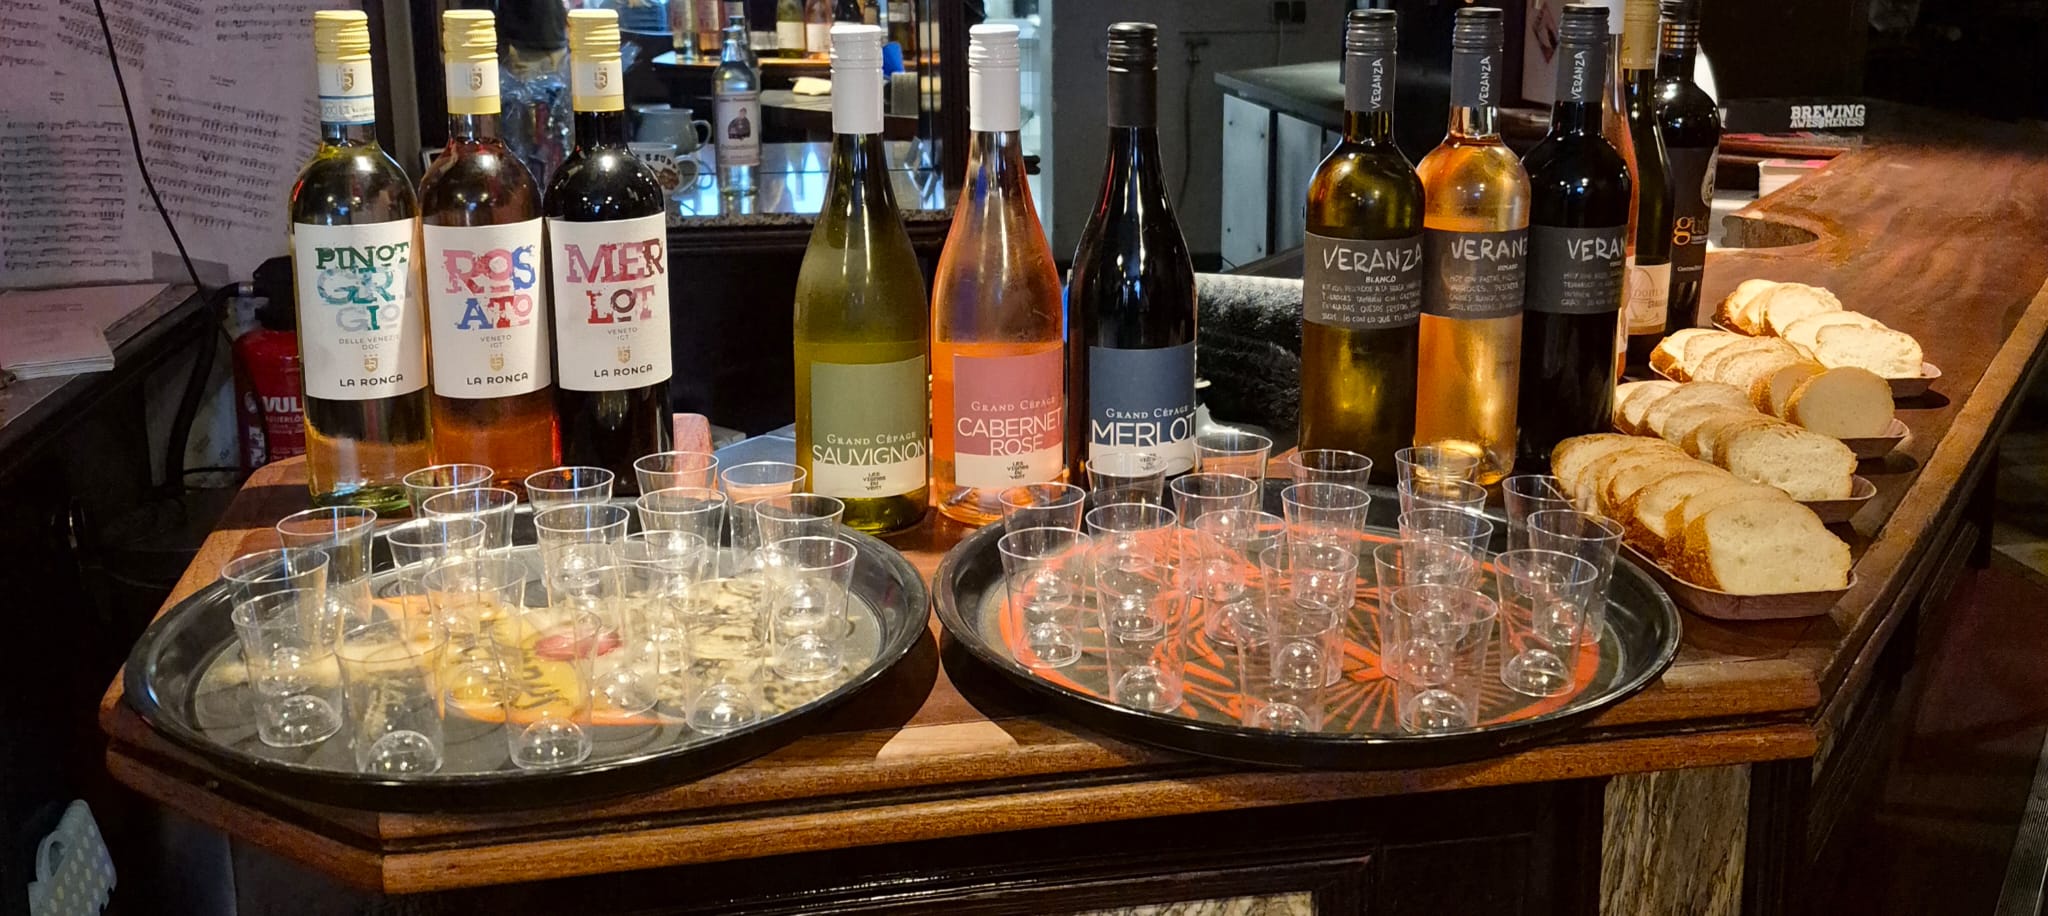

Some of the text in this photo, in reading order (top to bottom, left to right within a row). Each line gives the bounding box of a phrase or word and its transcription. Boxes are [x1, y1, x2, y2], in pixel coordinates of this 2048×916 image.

[1371, 58, 1384, 110] VERANZA
[1479, 56, 1492, 106] VERANZA
[1571, 51, 1585, 100] VERANZA
[1790, 117, 1865, 128] AWESOMENESS
[1791, 105, 1866, 119] BREWING
[315, 241, 409, 270] PINOT
[442, 245, 536, 294] ROS
[564, 238, 664, 283] MER
[1323, 243, 1423, 273] VERANZA
[1366, 276, 1397, 284] BLANCO
[335, 304, 401, 332] GIO
[454, 294, 533, 331] ATO
[586, 285, 655, 324] LOT
[480, 334, 512, 342] VENETO
[607, 327, 638, 335] VENETO
[340, 373, 404, 387] LA RONCA
[466, 372, 529, 386] LA RONCA
[594, 364, 653, 378] LA RONCA
[971, 401, 1015, 412] GRAND
[1105, 408, 1149, 419] GRAND
[957, 407, 1062, 438] CABERNET
[1091, 411, 1195, 447] MERLOT
[812, 438, 926, 466] SAUVIGNON
[826, 433, 871, 446] GRAND
[990, 433, 1044, 456] ROSÉ
